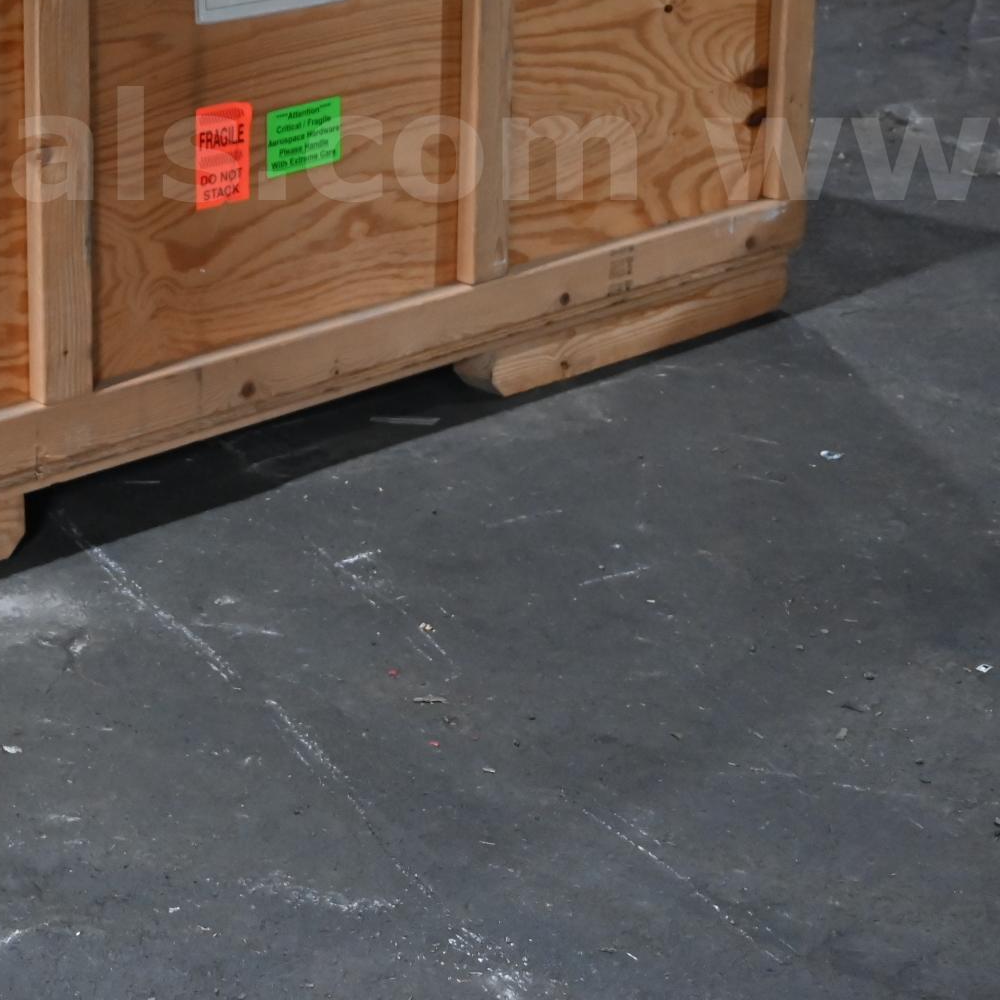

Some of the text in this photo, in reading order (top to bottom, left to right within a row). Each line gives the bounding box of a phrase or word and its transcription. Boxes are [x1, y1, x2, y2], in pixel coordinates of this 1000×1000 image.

[276, 120, 302, 134] Critical
[307, 116, 332, 127] Fragile
[200, 124, 244, 149] FRAGILE
[200, 168, 242, 186] DO NOT
[203, 184, 240, 201] STACK
